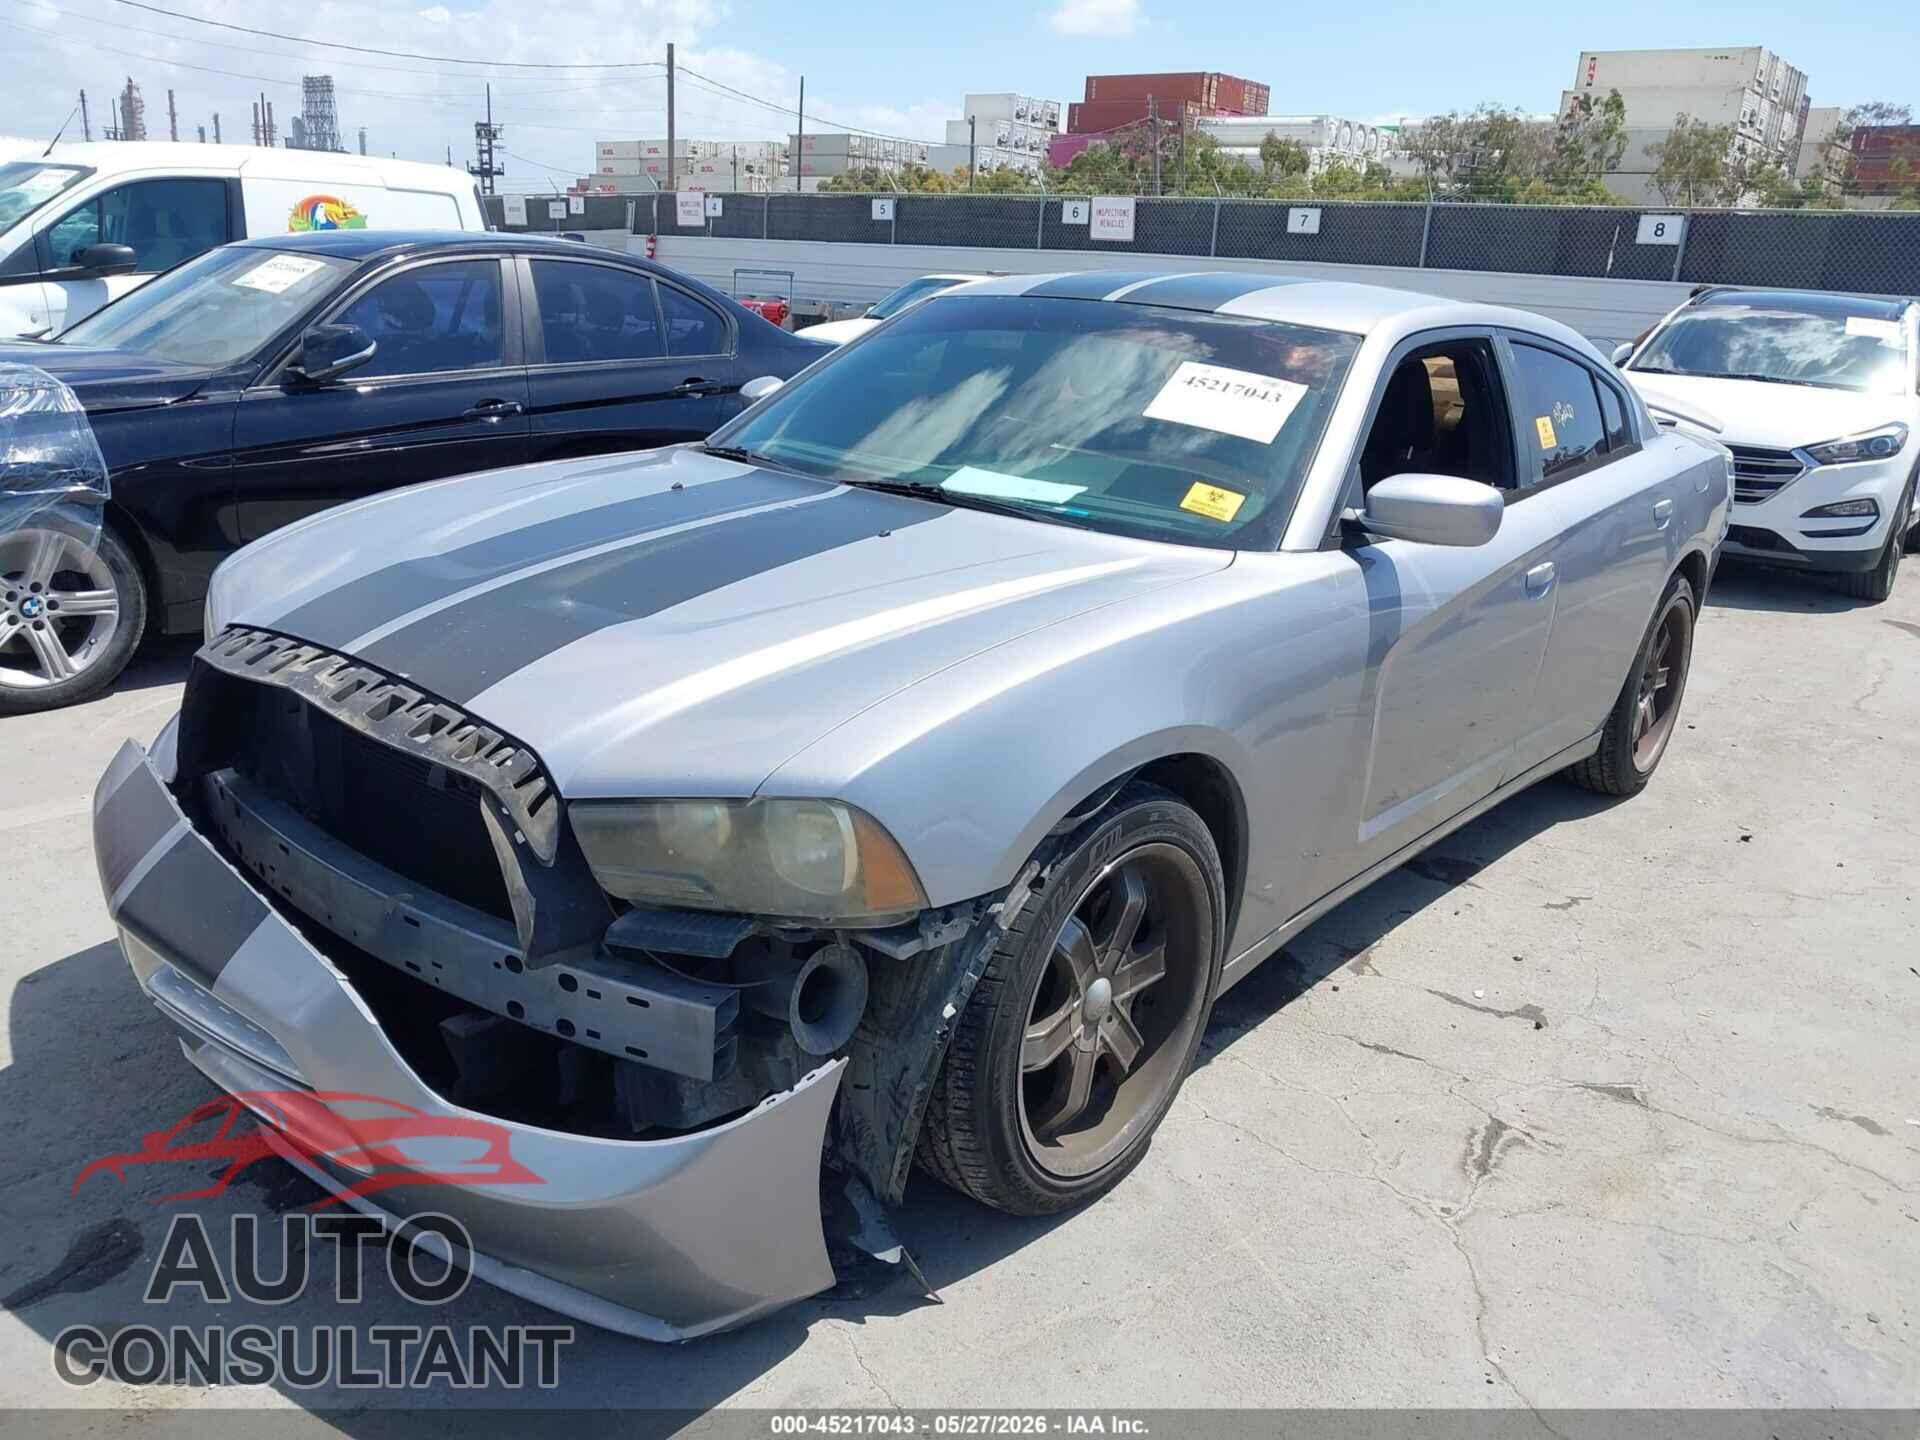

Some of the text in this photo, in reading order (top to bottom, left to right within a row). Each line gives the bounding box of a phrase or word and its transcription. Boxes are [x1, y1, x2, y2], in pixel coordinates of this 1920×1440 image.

[879, 204, 886, 215] 5
[1072, 206, 1079, 218] 6
[1300, 214, 1309, 227] 7
[1654, 222, 1665, 237] 8
[1184, 375, 1282, 403] 45217043
